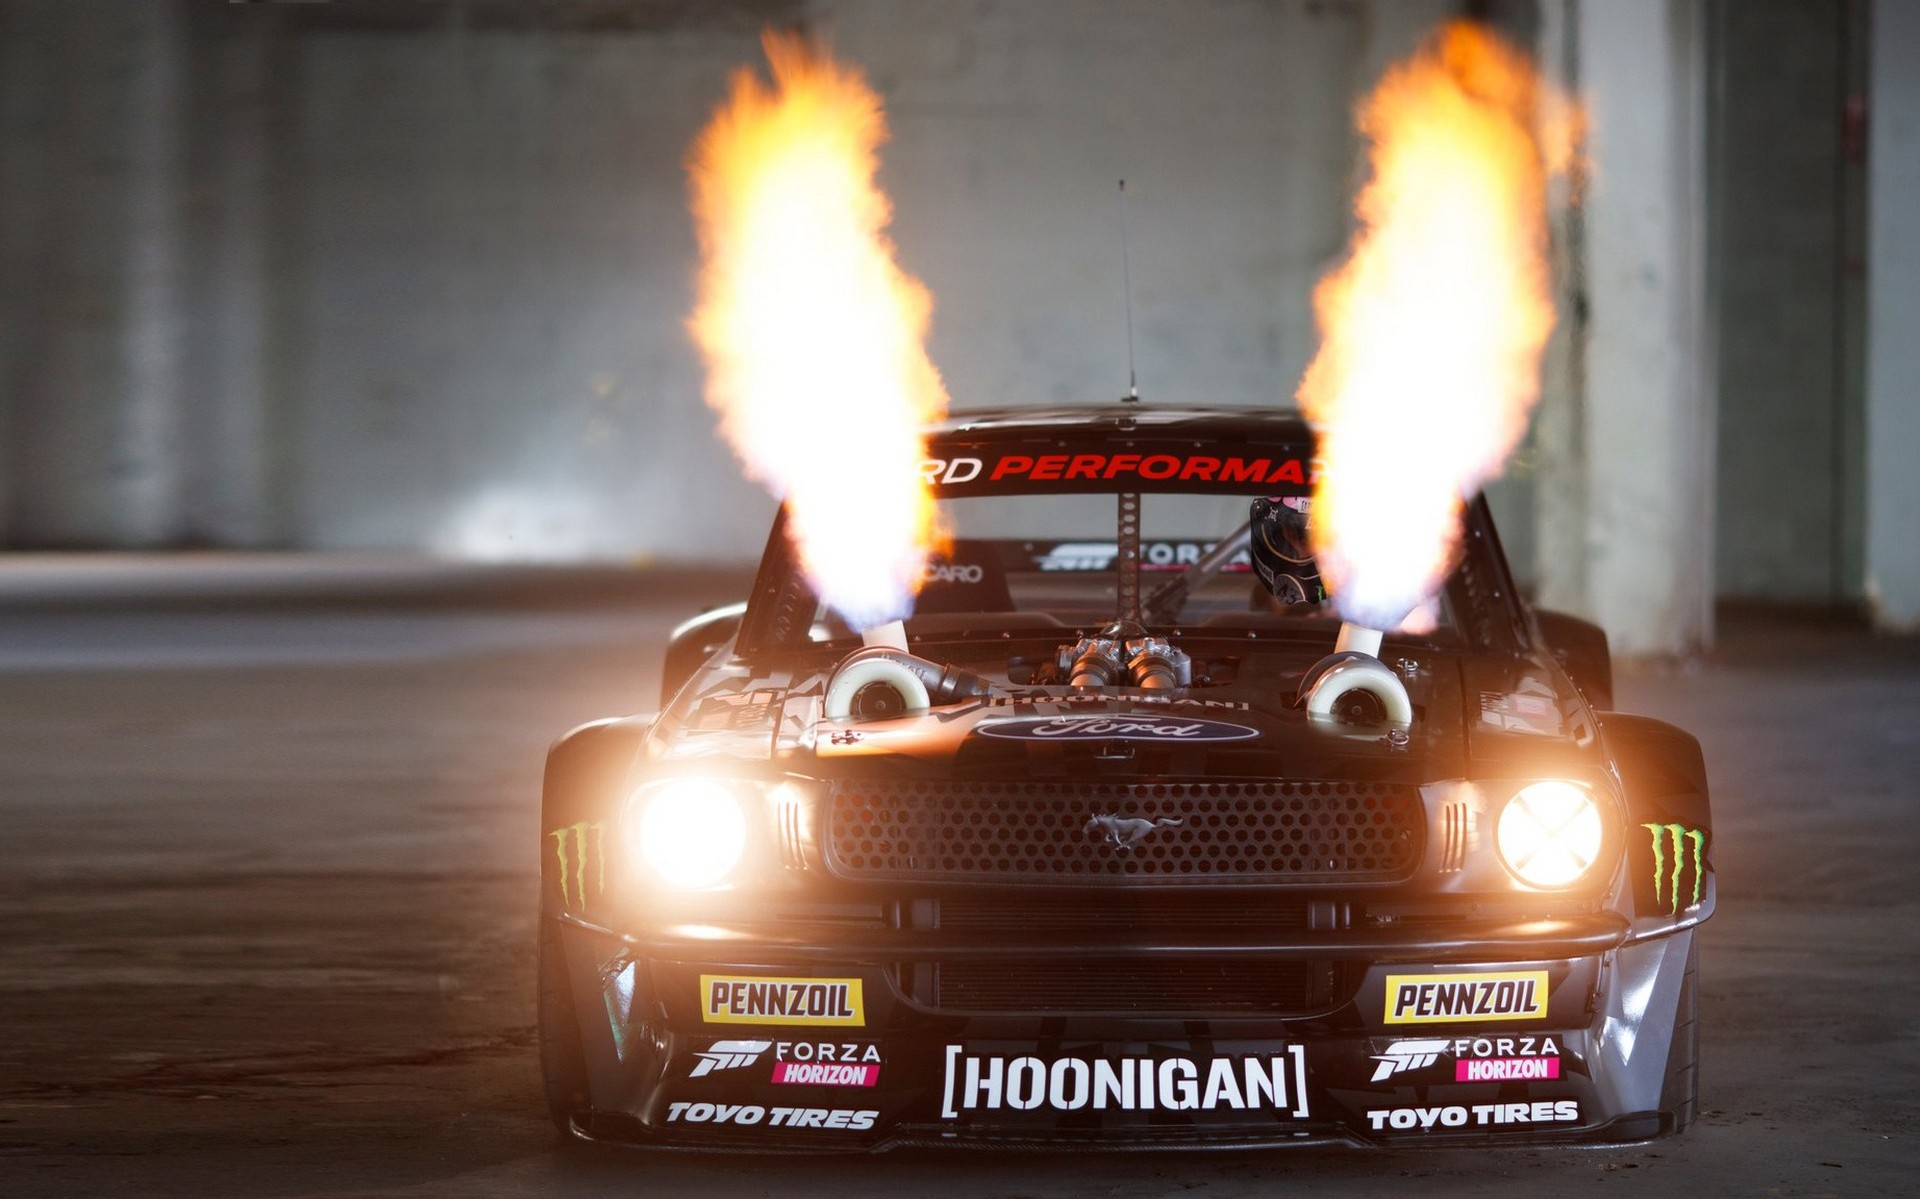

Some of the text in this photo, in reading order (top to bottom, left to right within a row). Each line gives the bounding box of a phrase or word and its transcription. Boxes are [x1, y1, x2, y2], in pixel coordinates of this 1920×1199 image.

[915, 458, 983, 485] RD
[924, 564, 983, 583] CARO
[1032, 715, 1204, 736] Ford
[710, 981, 854, 1018] PENNZOIL
[1393, 979, 1539, 1018] PENNZOIL
[776, 1042, 881, 1062] FORZA
[1455, 1038, 1559, 1058] FORZA
[783, 1064, 867, 1085] HORIZON
[1468, 1060, 1548, 1080] HORIZON
[667, 1103, 879, 1130] TOYO TIRES
[1367, 1101, 1578, 1130] TOYO TIRES
